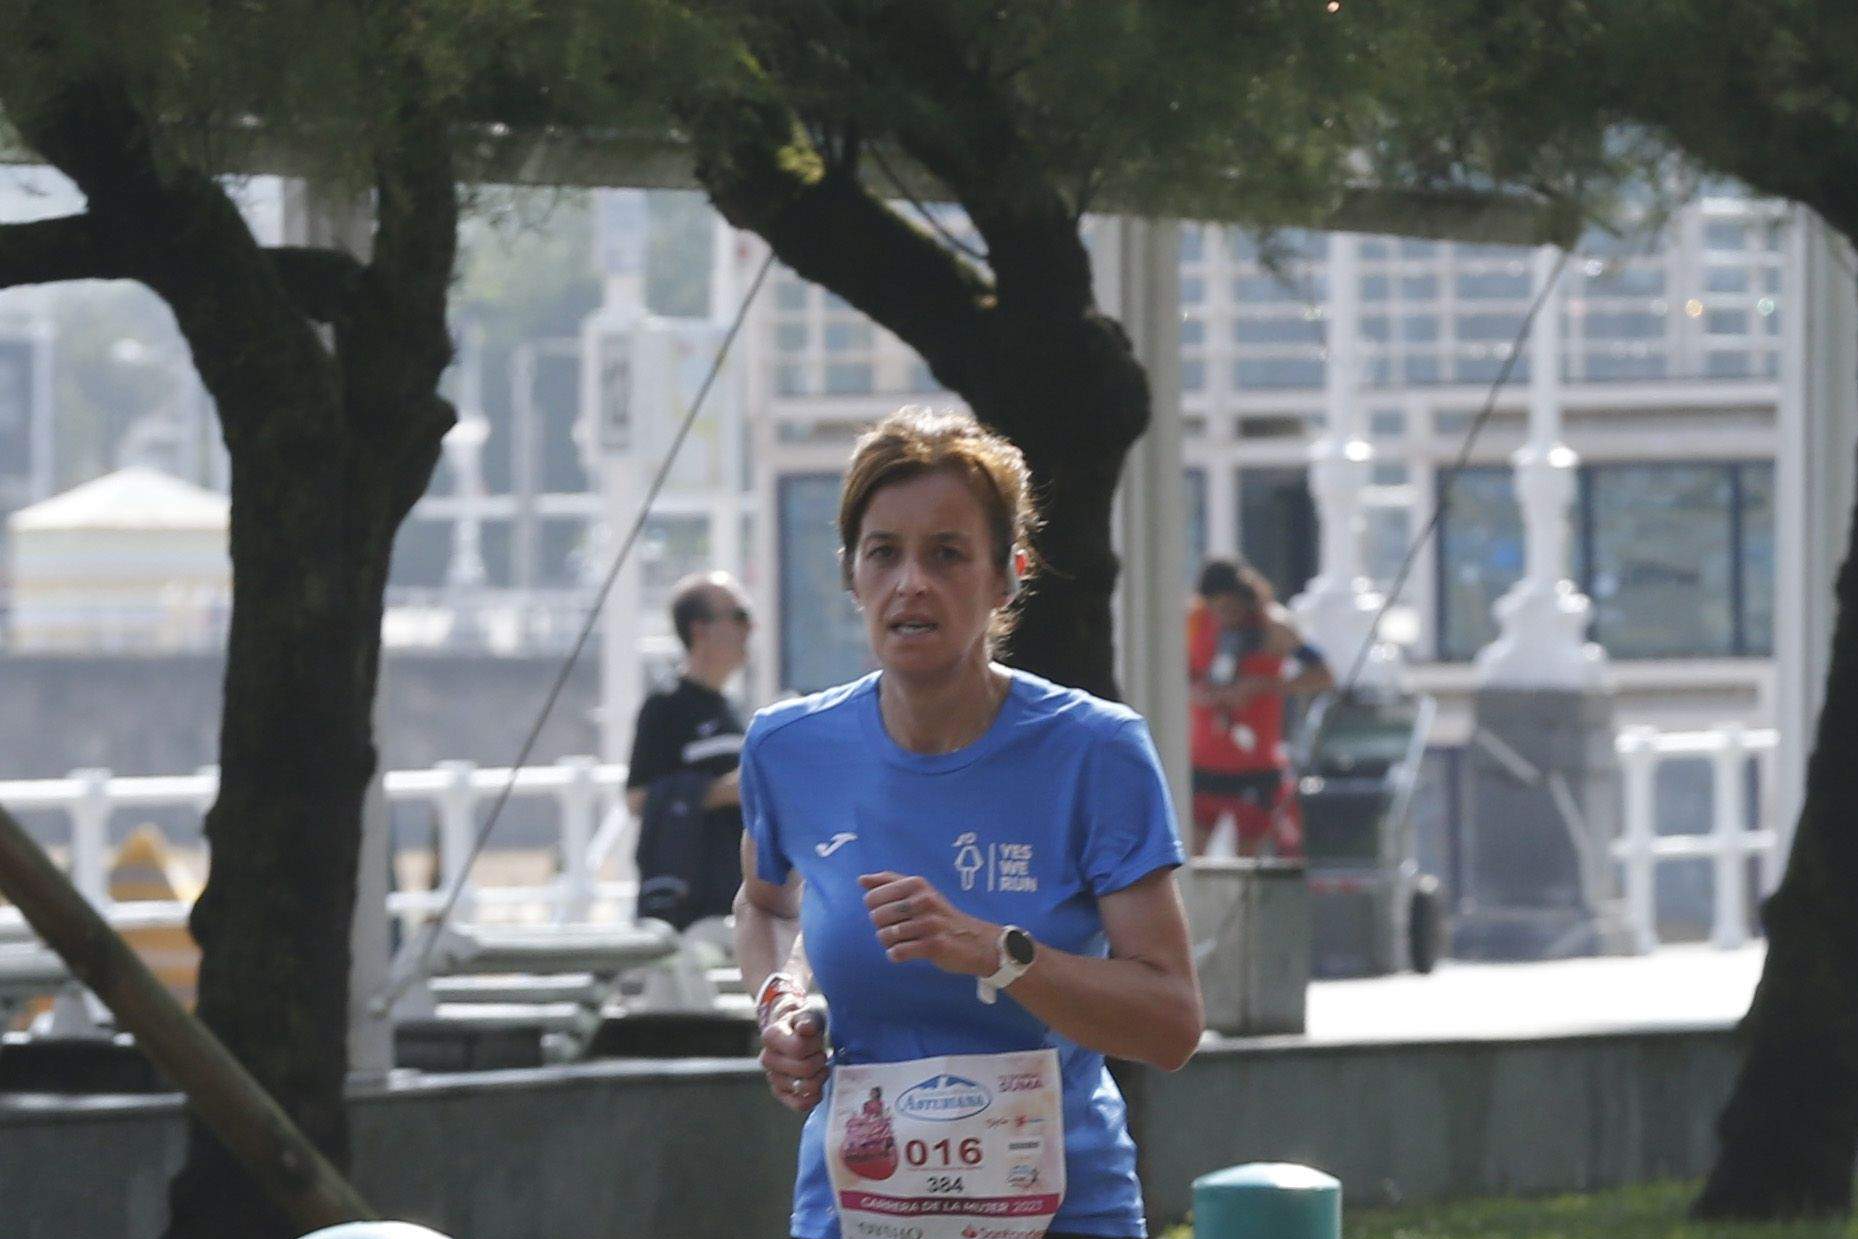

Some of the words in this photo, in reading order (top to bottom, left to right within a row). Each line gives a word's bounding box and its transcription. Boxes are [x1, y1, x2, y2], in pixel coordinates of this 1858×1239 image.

[1000, 843, 1032, 859] YES
[1000, 860, 1029, 875] WE
[1000, 876, 1038, 892] RUN
[905, 1136, 984, 1167] 016
[927, 1175, 965, 1194] 384
[943, 1200, 961, 1212] LA
